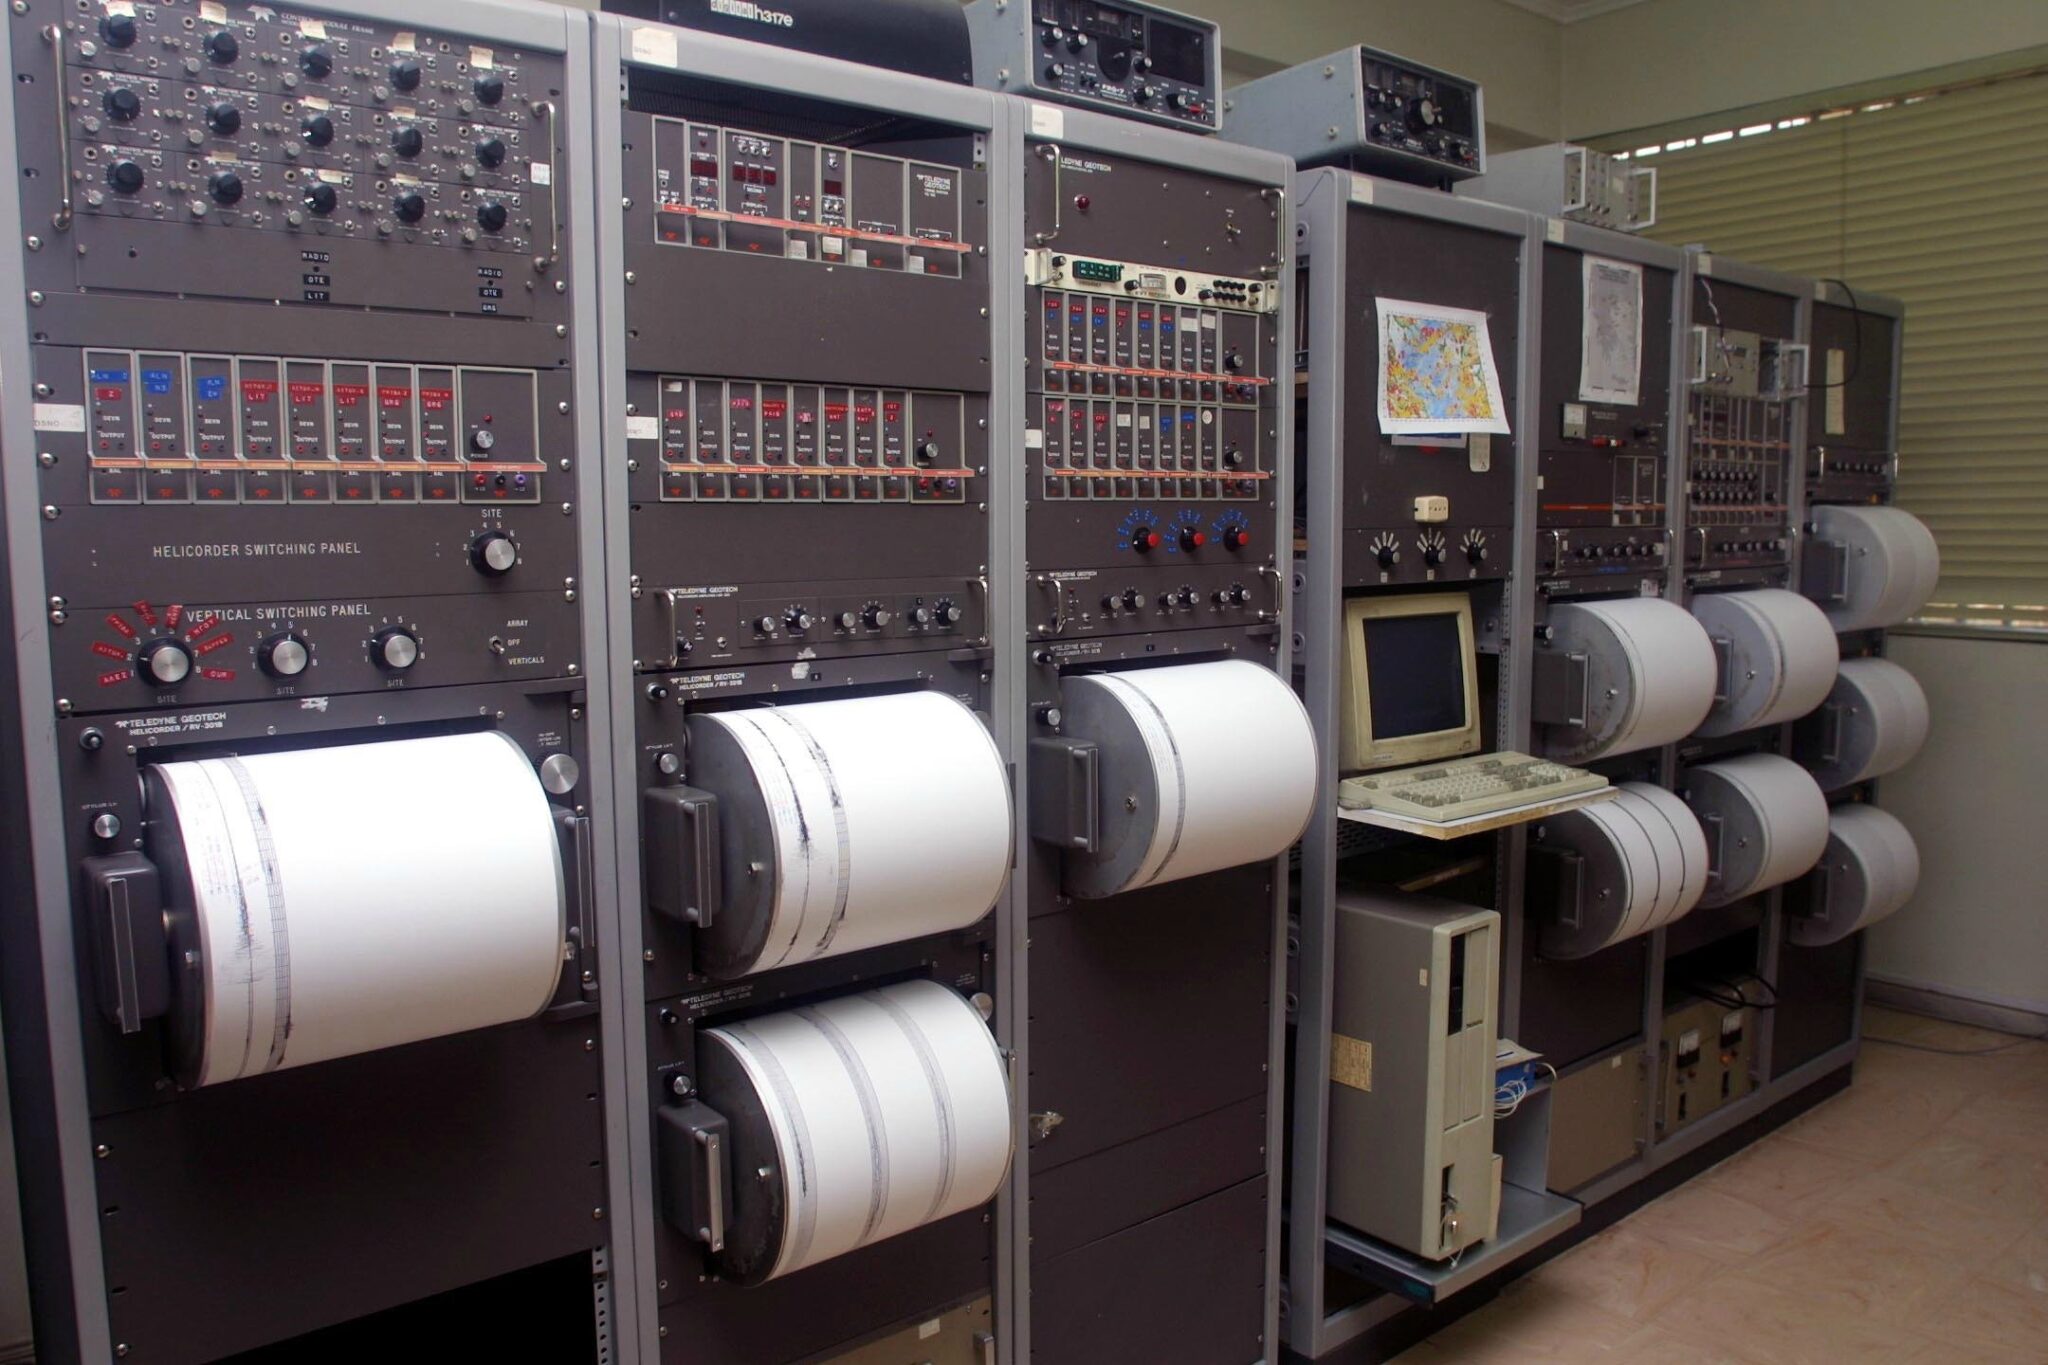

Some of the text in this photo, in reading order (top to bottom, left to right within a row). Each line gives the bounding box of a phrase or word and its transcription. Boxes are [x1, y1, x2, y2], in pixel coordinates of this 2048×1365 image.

[754, 3, 793, 27] h317e
[302, 252, 330, 262] RADIO
[477, 268, 502, 278] RADIO
[248, 392, 266, 401] LIT
[295, 394, 313, 402] LIT
[482, 509, 502, 518] SITE
[153, 542, 361, 558] HELICORDER SWITCHING PANEL
[186, 608, 252, 623] VERTICAL
[256, 605, 327, 620] SWITCHING
[331, 603, 371, 616] PANEL
[508, 656, 545, 665] VERTICALS
[387, 679, 404, 687] SITE
[276, 687, 296, 695] SITE
[156, 695, 177, 704] SITE
[130, 712, 227, 728] TELEDYNE GEOTECH
[129, 725, 181, 736] HELICORDER
